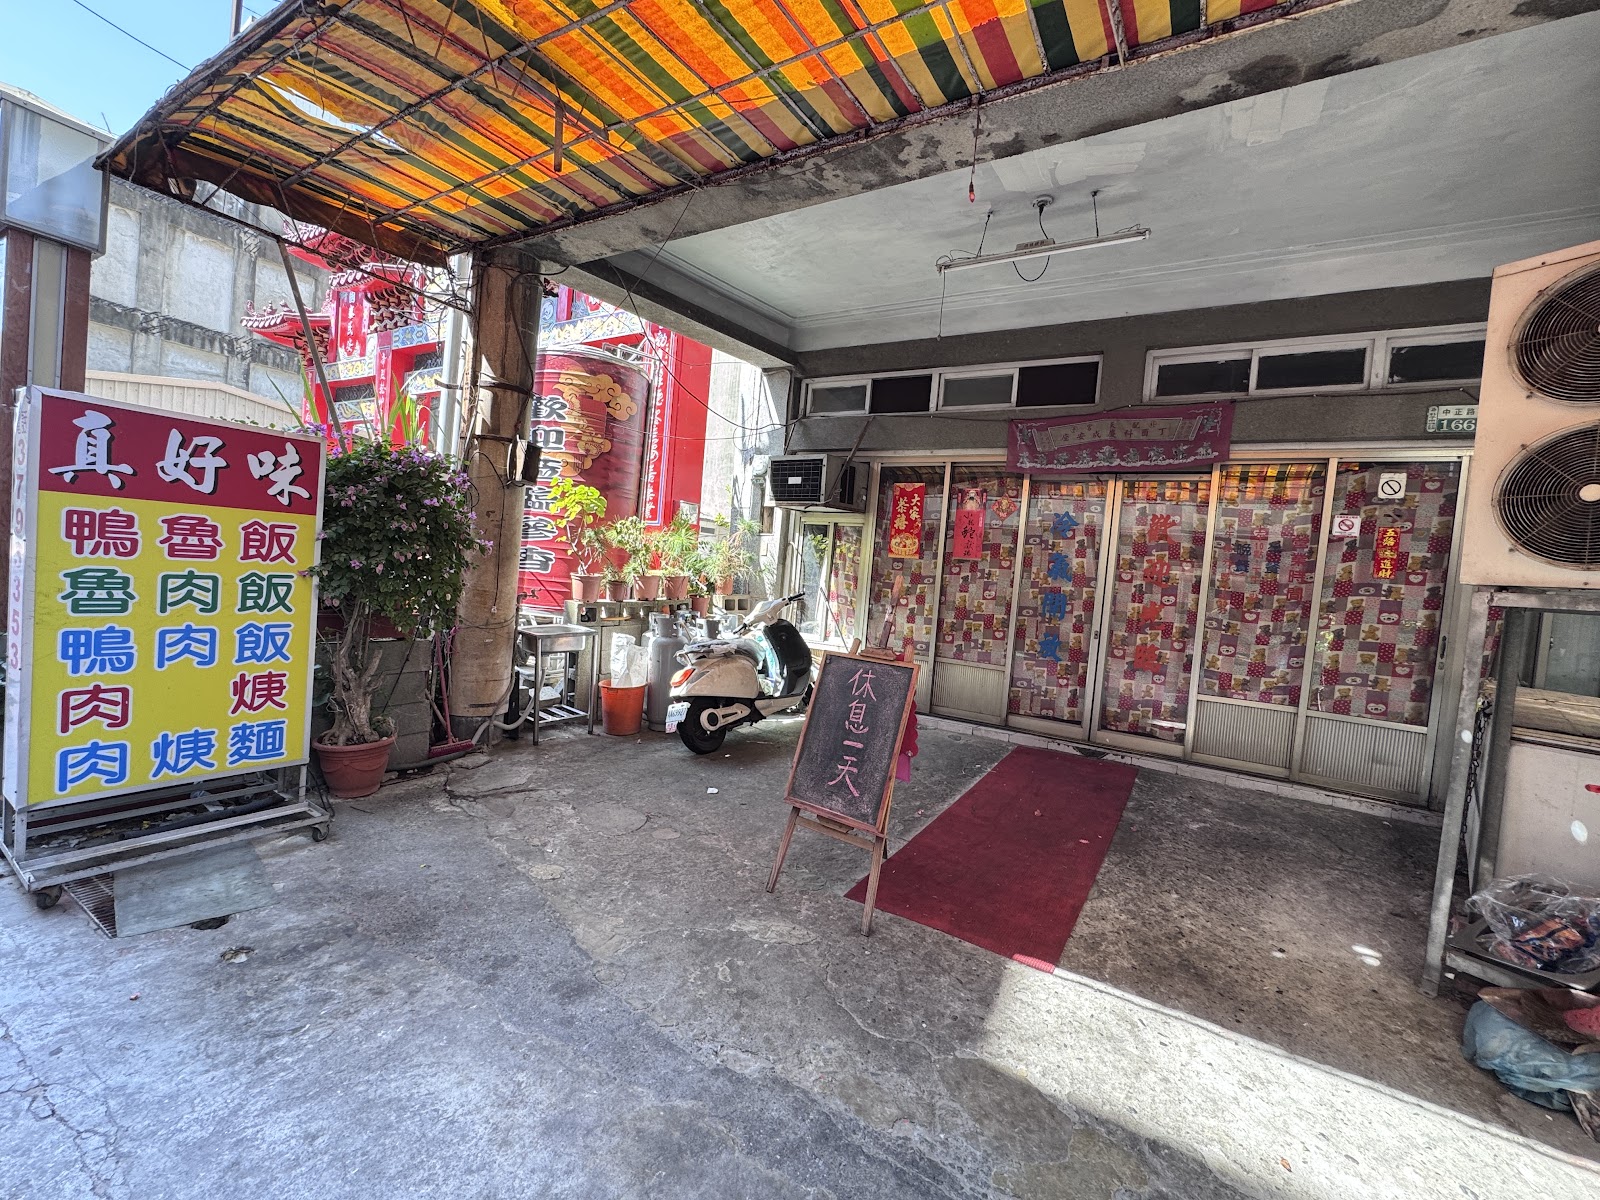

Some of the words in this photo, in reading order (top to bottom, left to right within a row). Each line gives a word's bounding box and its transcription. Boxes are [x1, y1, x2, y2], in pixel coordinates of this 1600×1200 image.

[1440, 419, 1476, 431] 166
[1442, 408, 1476, 416] 中正路
[48, 410, 312, 505] 真好味
[62, 508, 299, 565] 鴨魯飯
[60, 566, 297, 616] 魯肉飯
[58, 622, 294, 674] 鴨肉飯
[826, 668, 877, 797] 休息一天
